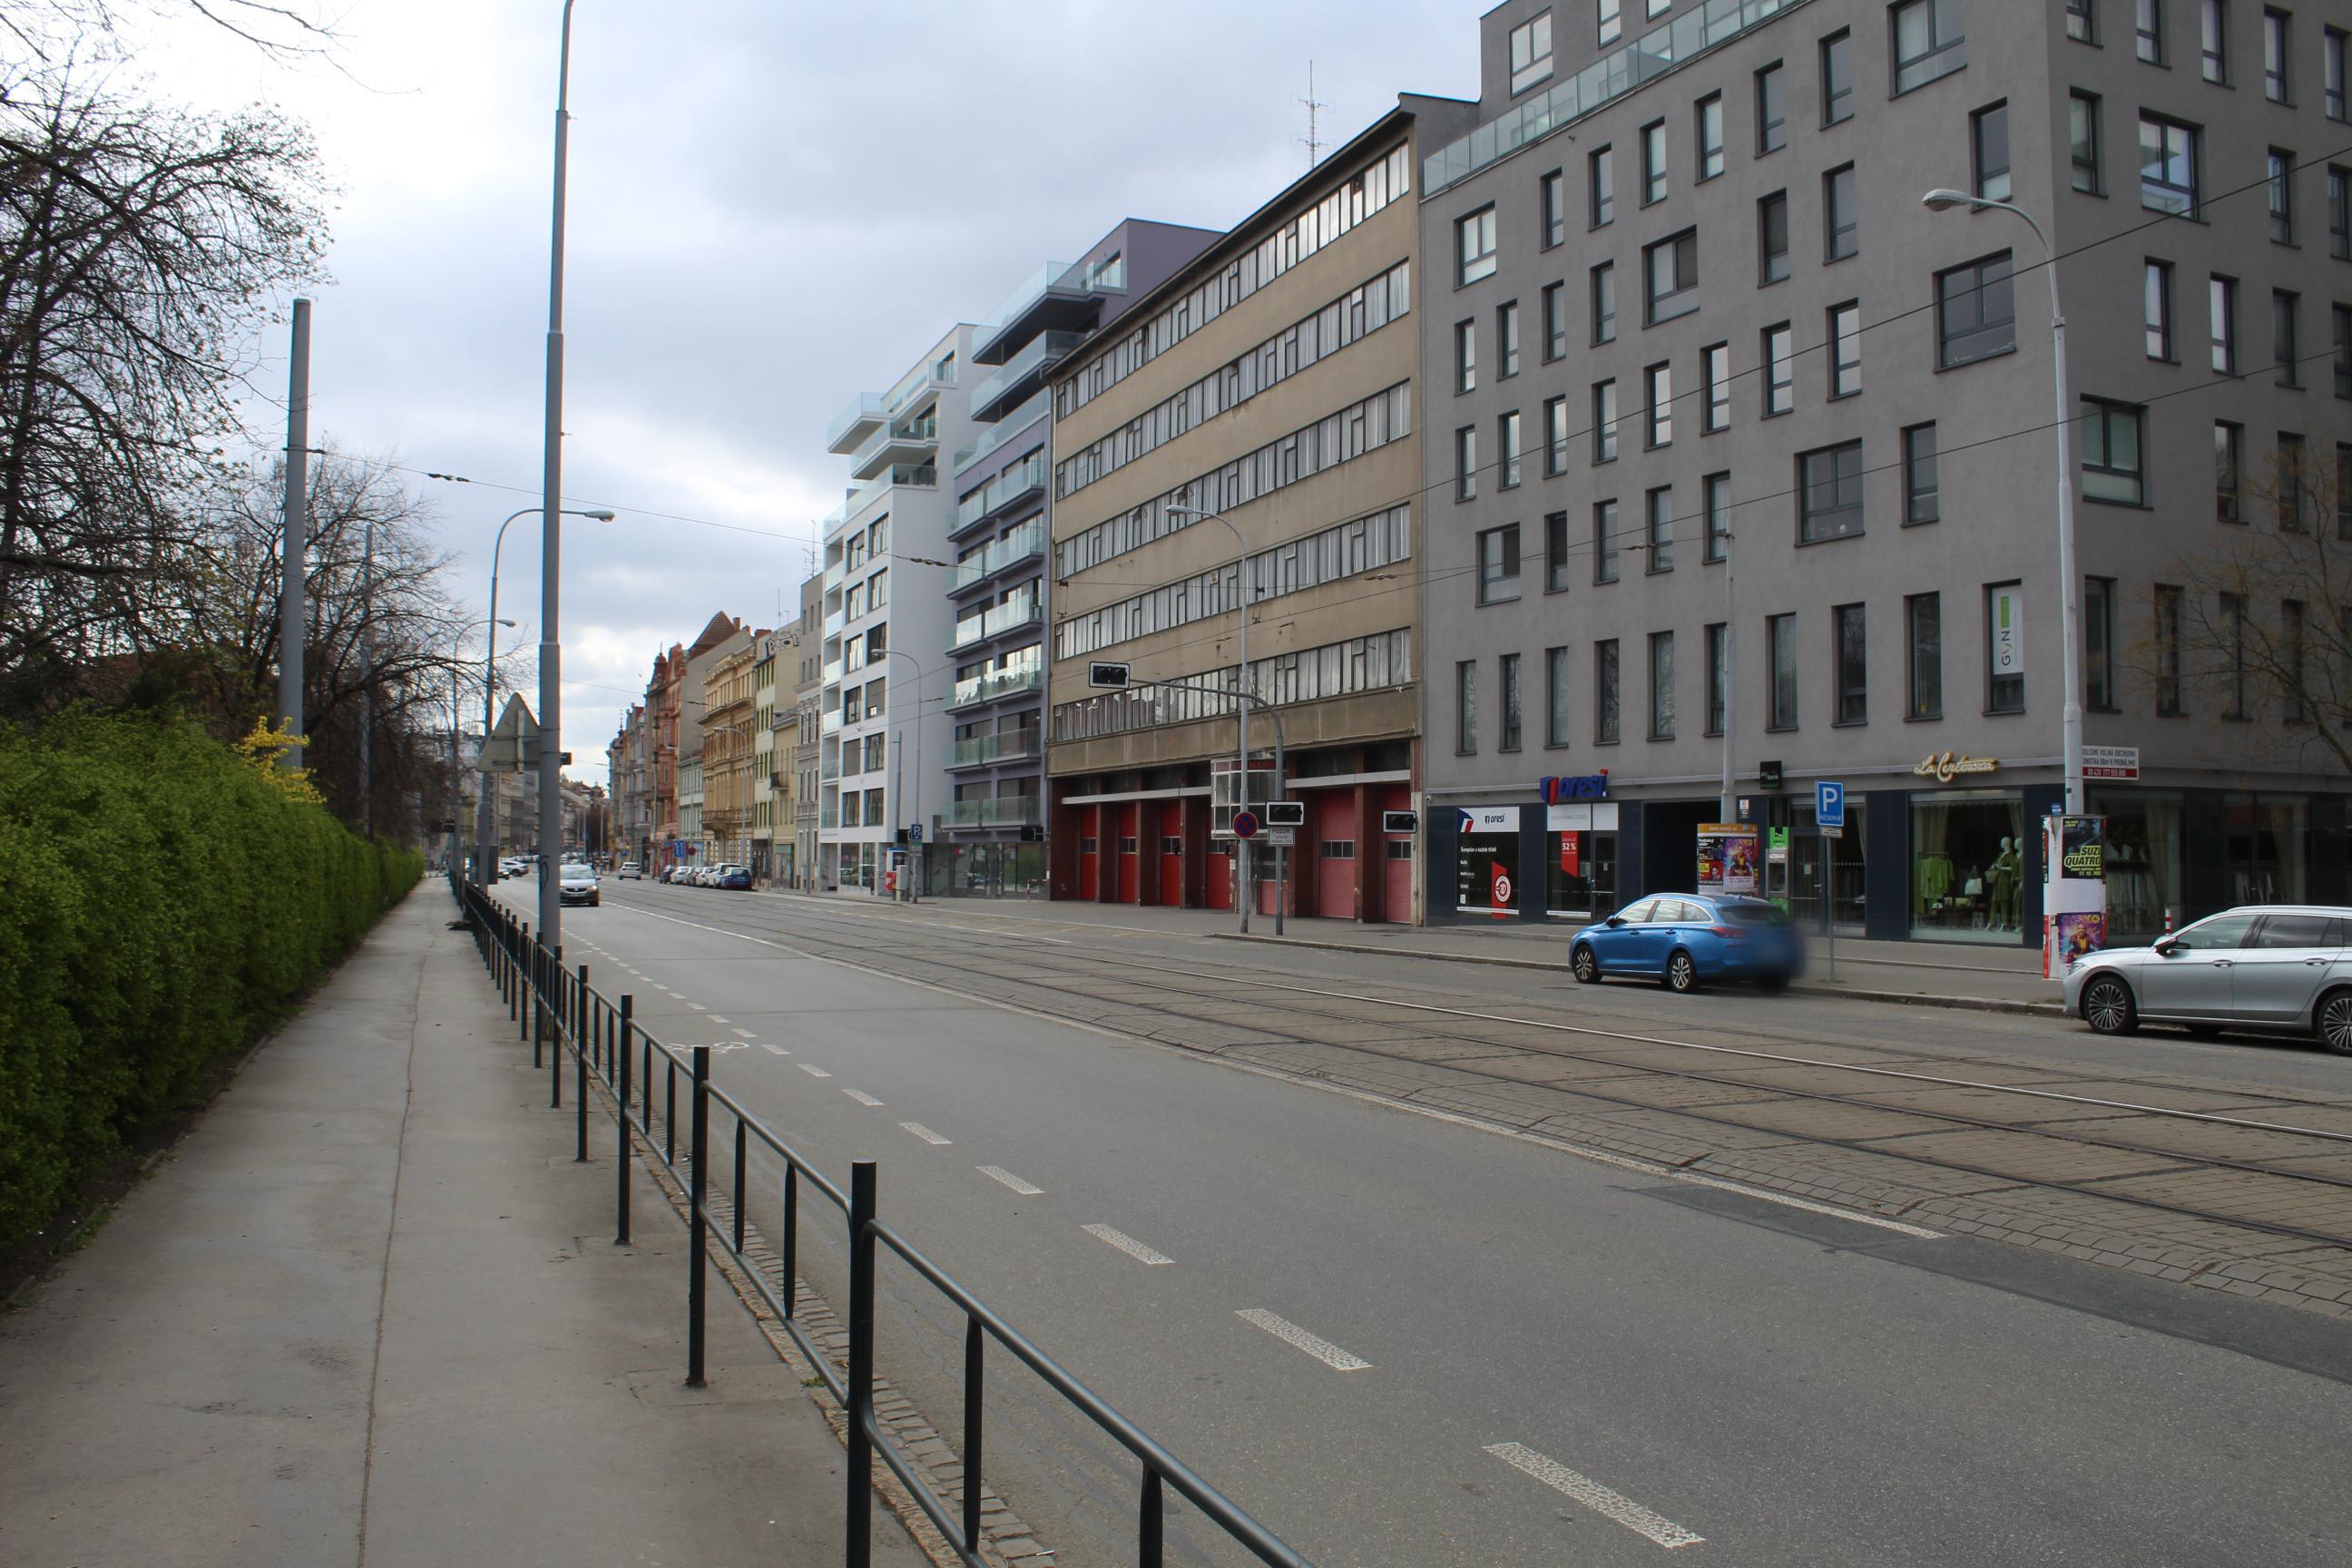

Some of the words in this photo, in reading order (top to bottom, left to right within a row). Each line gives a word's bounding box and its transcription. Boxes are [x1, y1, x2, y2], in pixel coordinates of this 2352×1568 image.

[1559, 769, 1608, 799] oresi
[1822, 787, 1838, 812] P
[1490, 813, 1505, 823] oresi
[914, 826, 920, 836] P
[1562, 842, 1570, 850] 52
[1570, 842, 1576, 850] %
[2064, 856, 2101, 867] QUATRO
